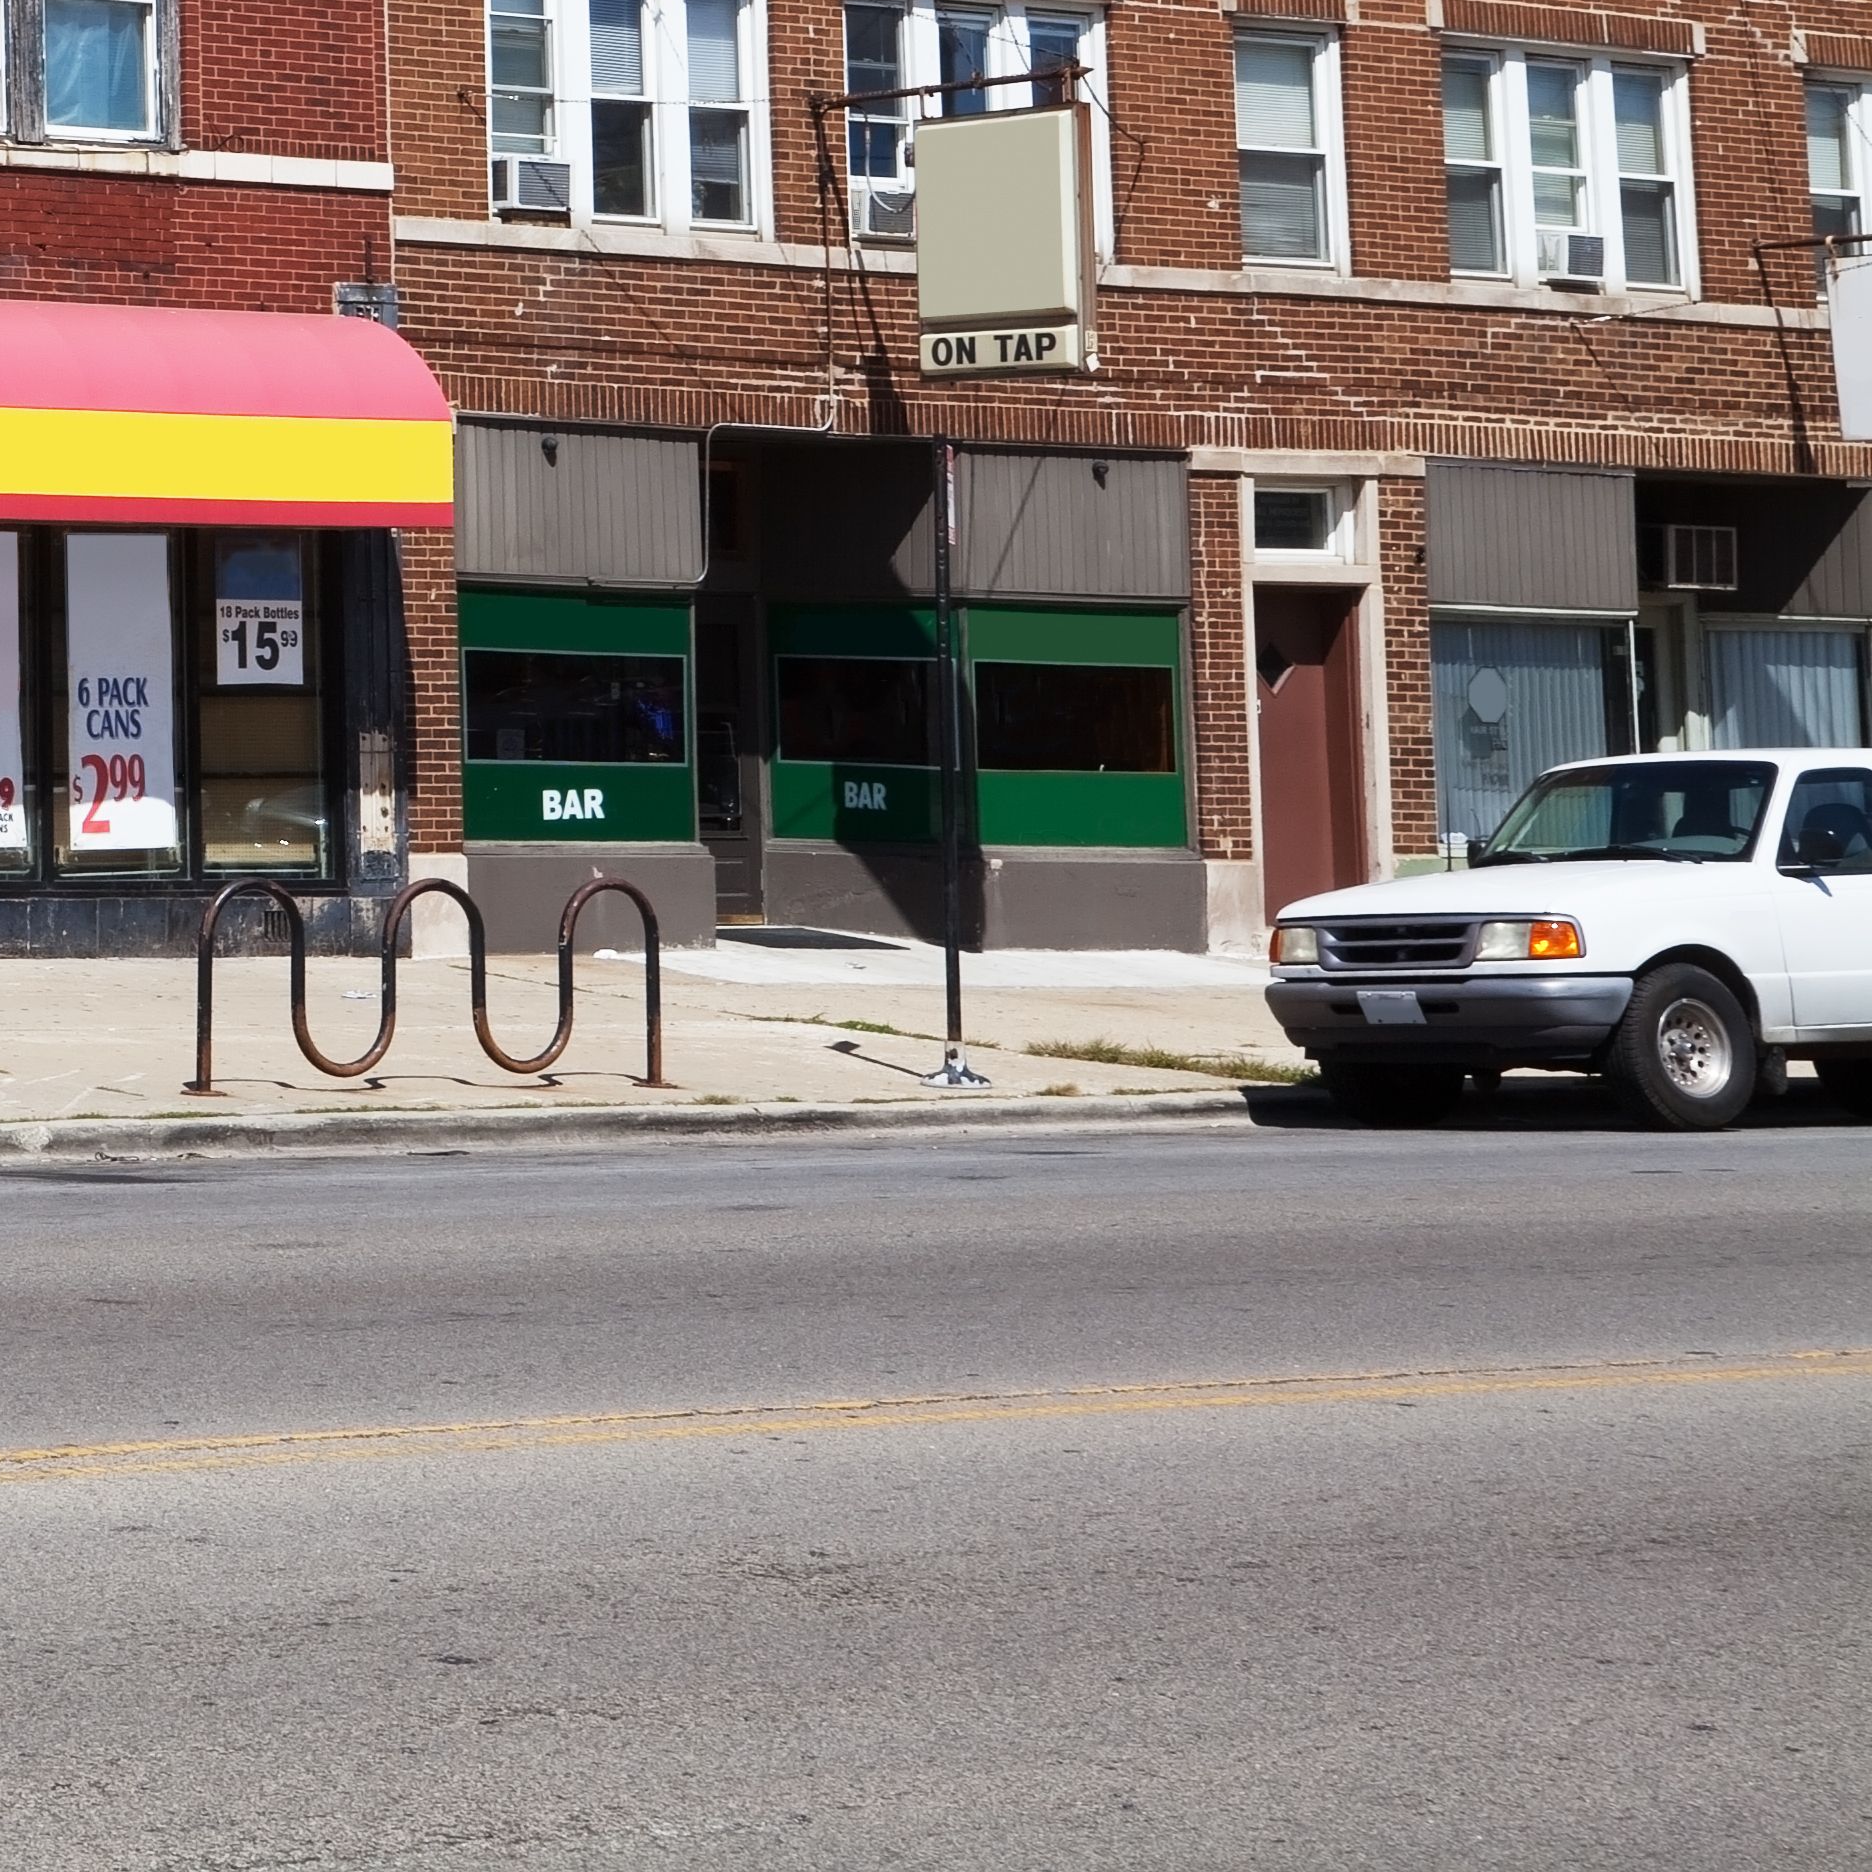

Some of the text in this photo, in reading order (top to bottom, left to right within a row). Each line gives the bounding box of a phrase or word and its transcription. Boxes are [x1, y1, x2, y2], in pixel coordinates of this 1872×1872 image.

[932, 337, 975, 366] ON
[994, 332, 1056, 362] TAP
[220, 606, 299, 619] 18 Pack Bottles
[78, 677, 149, 709] 6 PACK
[86, 709, 142, 739] CANS
[542, 789, 605, 820] BAR
[844, 781, 887, 811] BAR
